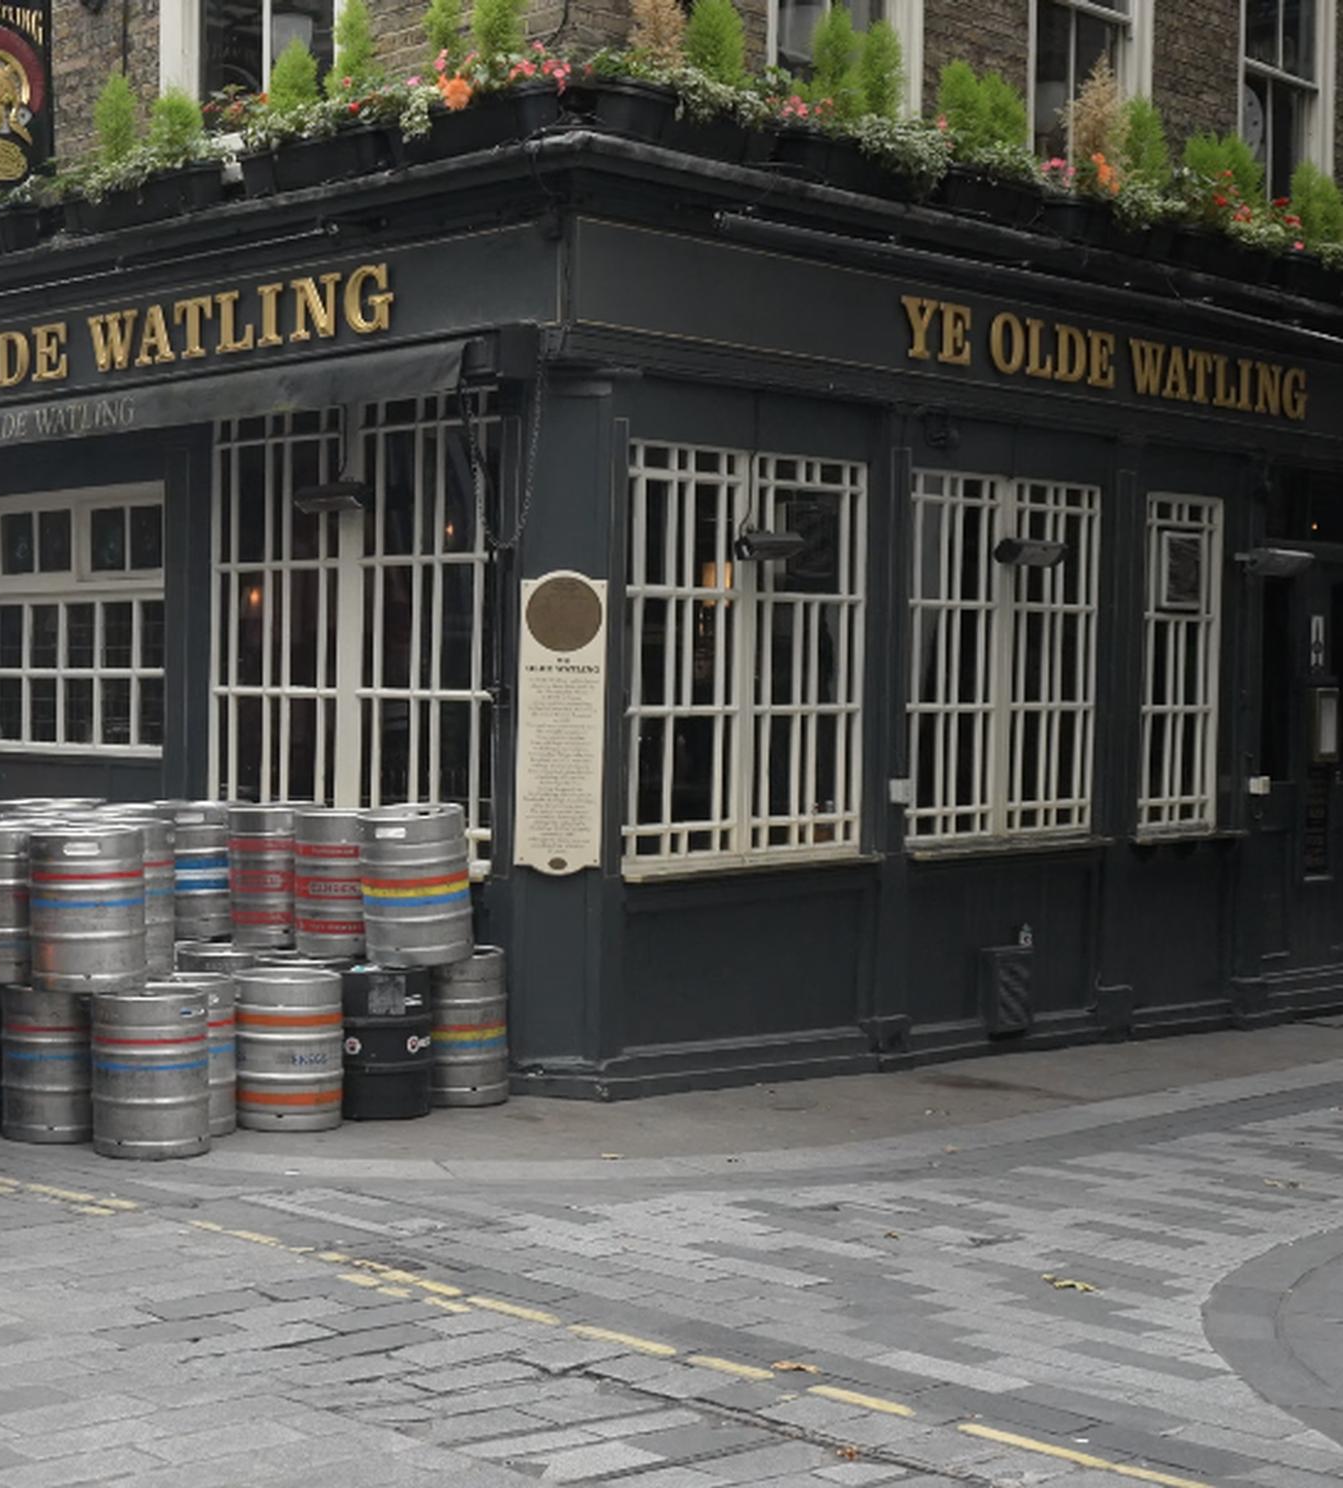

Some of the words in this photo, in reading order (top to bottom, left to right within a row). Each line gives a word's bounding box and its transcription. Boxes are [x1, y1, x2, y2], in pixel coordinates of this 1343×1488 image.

[87, 262, 394, 373] WATLING
[901, 296, 971, 365] YE
[989, 312, 1115, 388] OLDE
[1129, 337, 1308, 420] WATLING
[34, 396, 135, 434] WATLING
